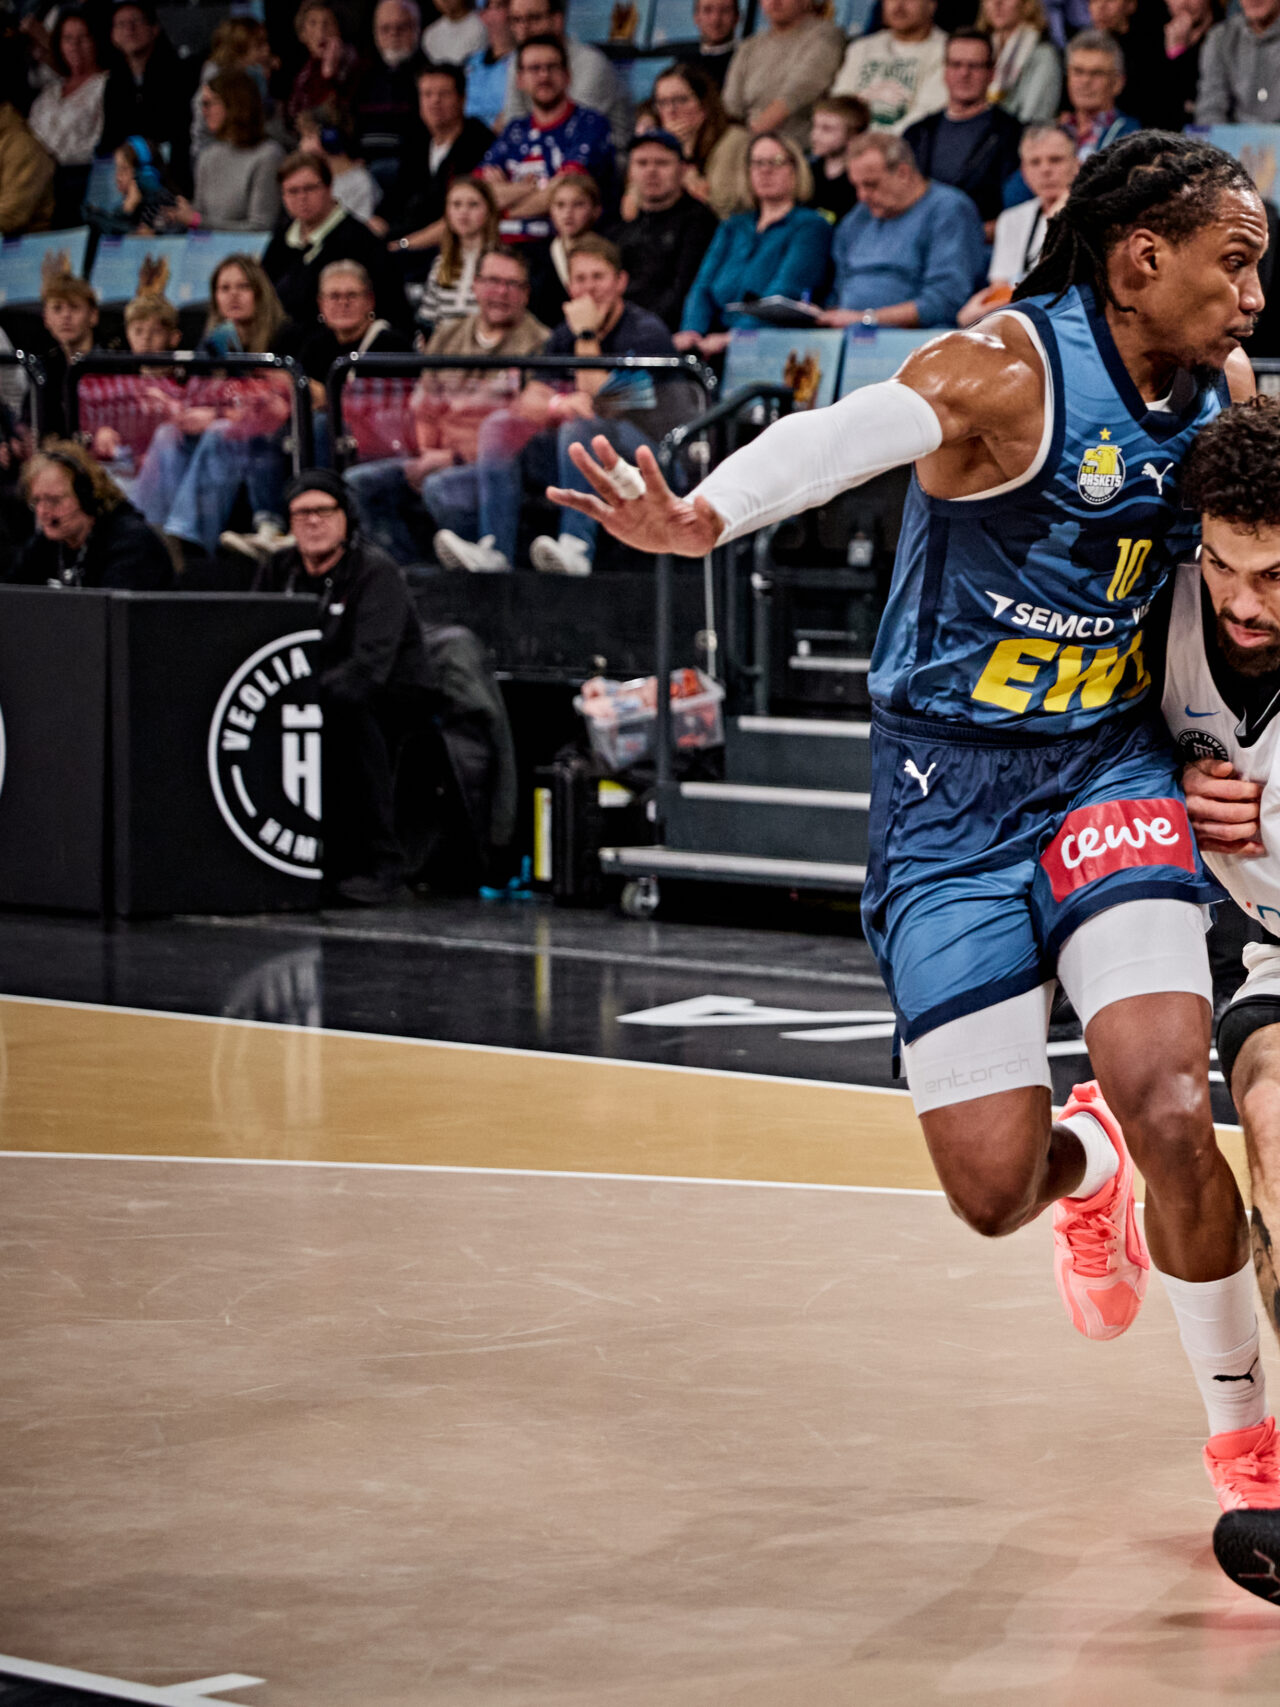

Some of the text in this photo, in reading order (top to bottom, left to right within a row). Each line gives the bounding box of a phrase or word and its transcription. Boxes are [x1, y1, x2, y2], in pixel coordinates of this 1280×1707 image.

[1080, 473, 1122, 487] BASKETS
[1106, 538, 1152, 602] 10
[222, 646, 312, 751] VEOLIA
[258, 817, 322, 863] HAM
[1061, 817, 1179, 869] cewe
